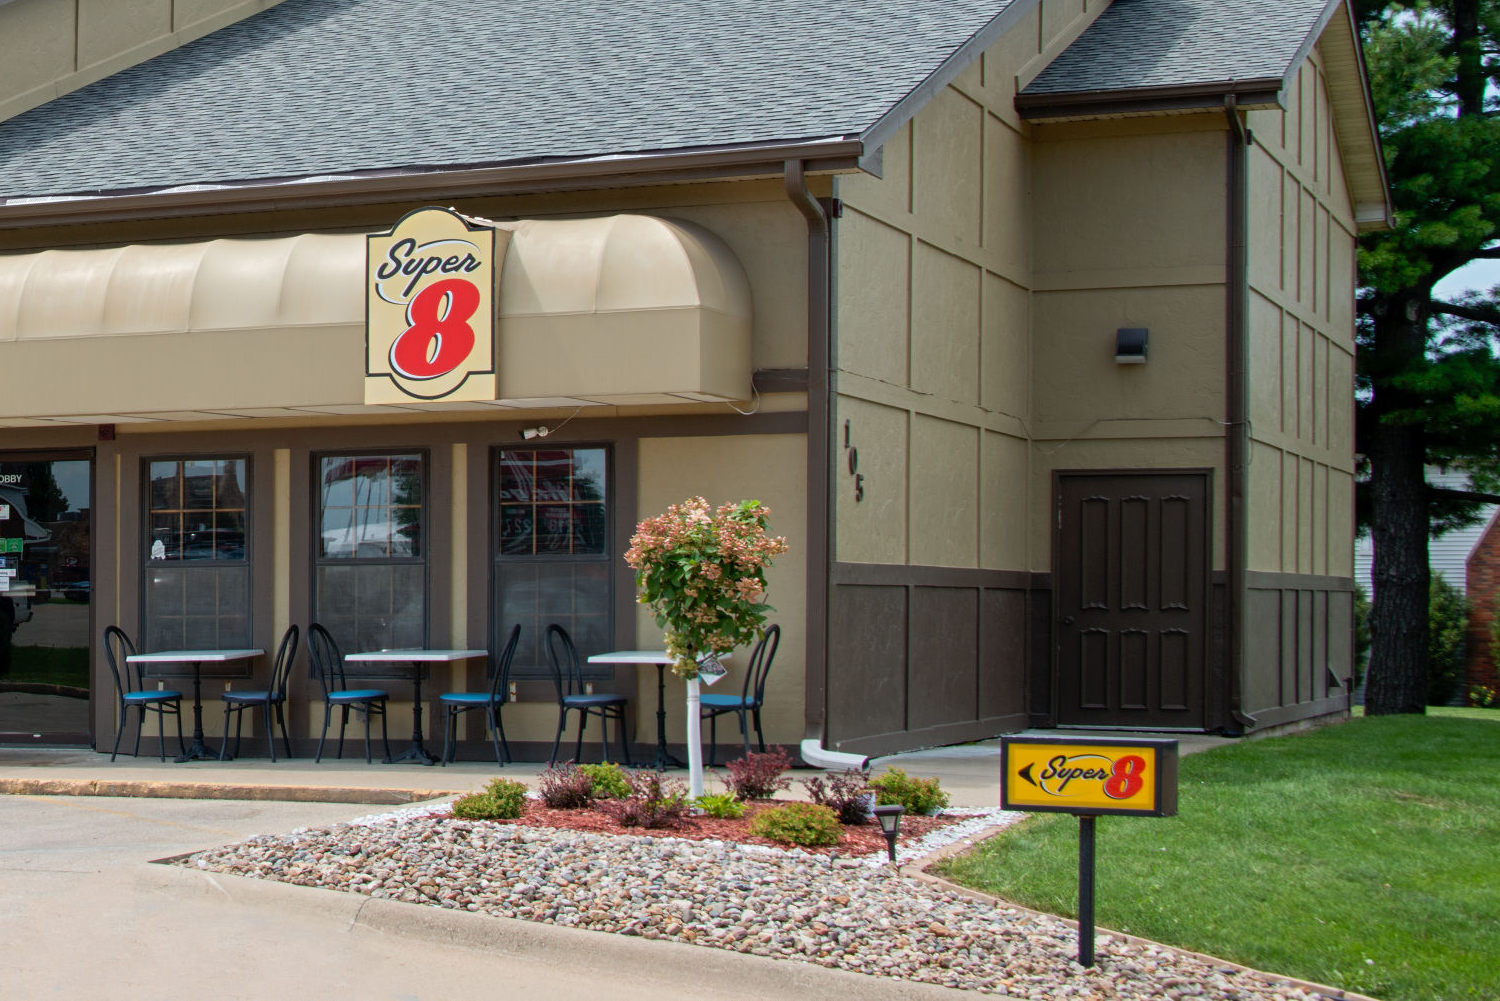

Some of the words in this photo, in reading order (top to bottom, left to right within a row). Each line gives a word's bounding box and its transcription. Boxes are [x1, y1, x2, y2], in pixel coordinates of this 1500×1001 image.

[376, 237, 482, 299] Super
[388, 278, 481, 381] 8
[1039, 755, 1109, 793] Super
[1103, 755, 1146, 800] 8
